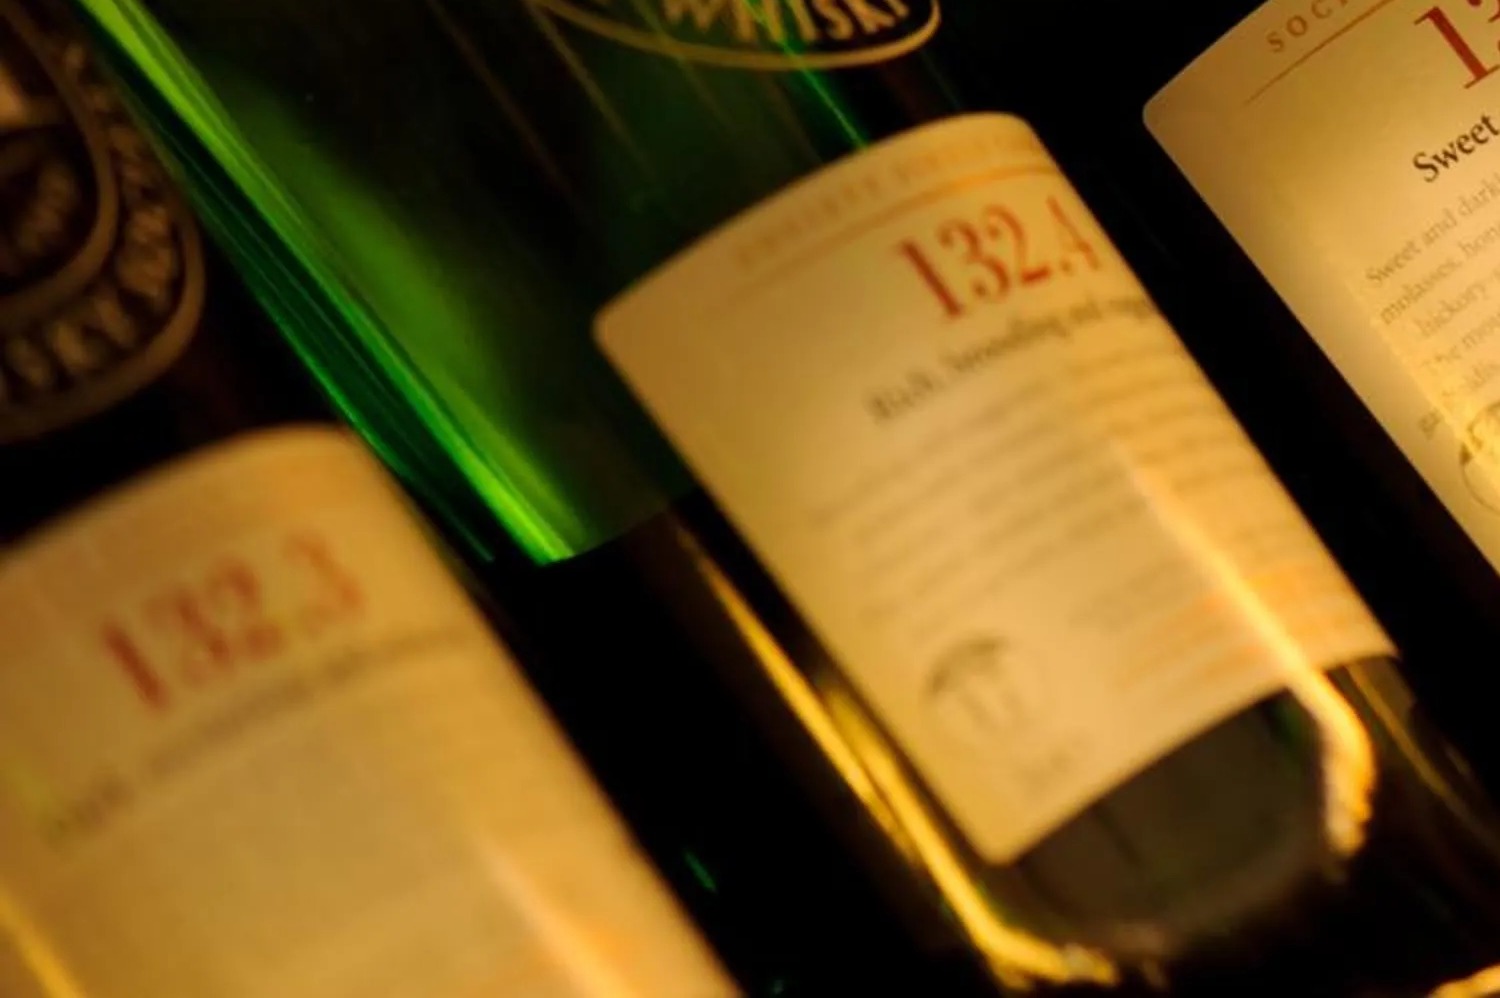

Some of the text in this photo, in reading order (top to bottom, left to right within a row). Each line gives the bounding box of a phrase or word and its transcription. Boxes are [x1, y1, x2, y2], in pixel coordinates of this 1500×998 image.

[1412, 116, 1499, 183] Sweet
[896, 198, 1102, 321] 132.4
[1363, 238, 1420, 286] Sweet
[1419, 206, 1458, 246] and
